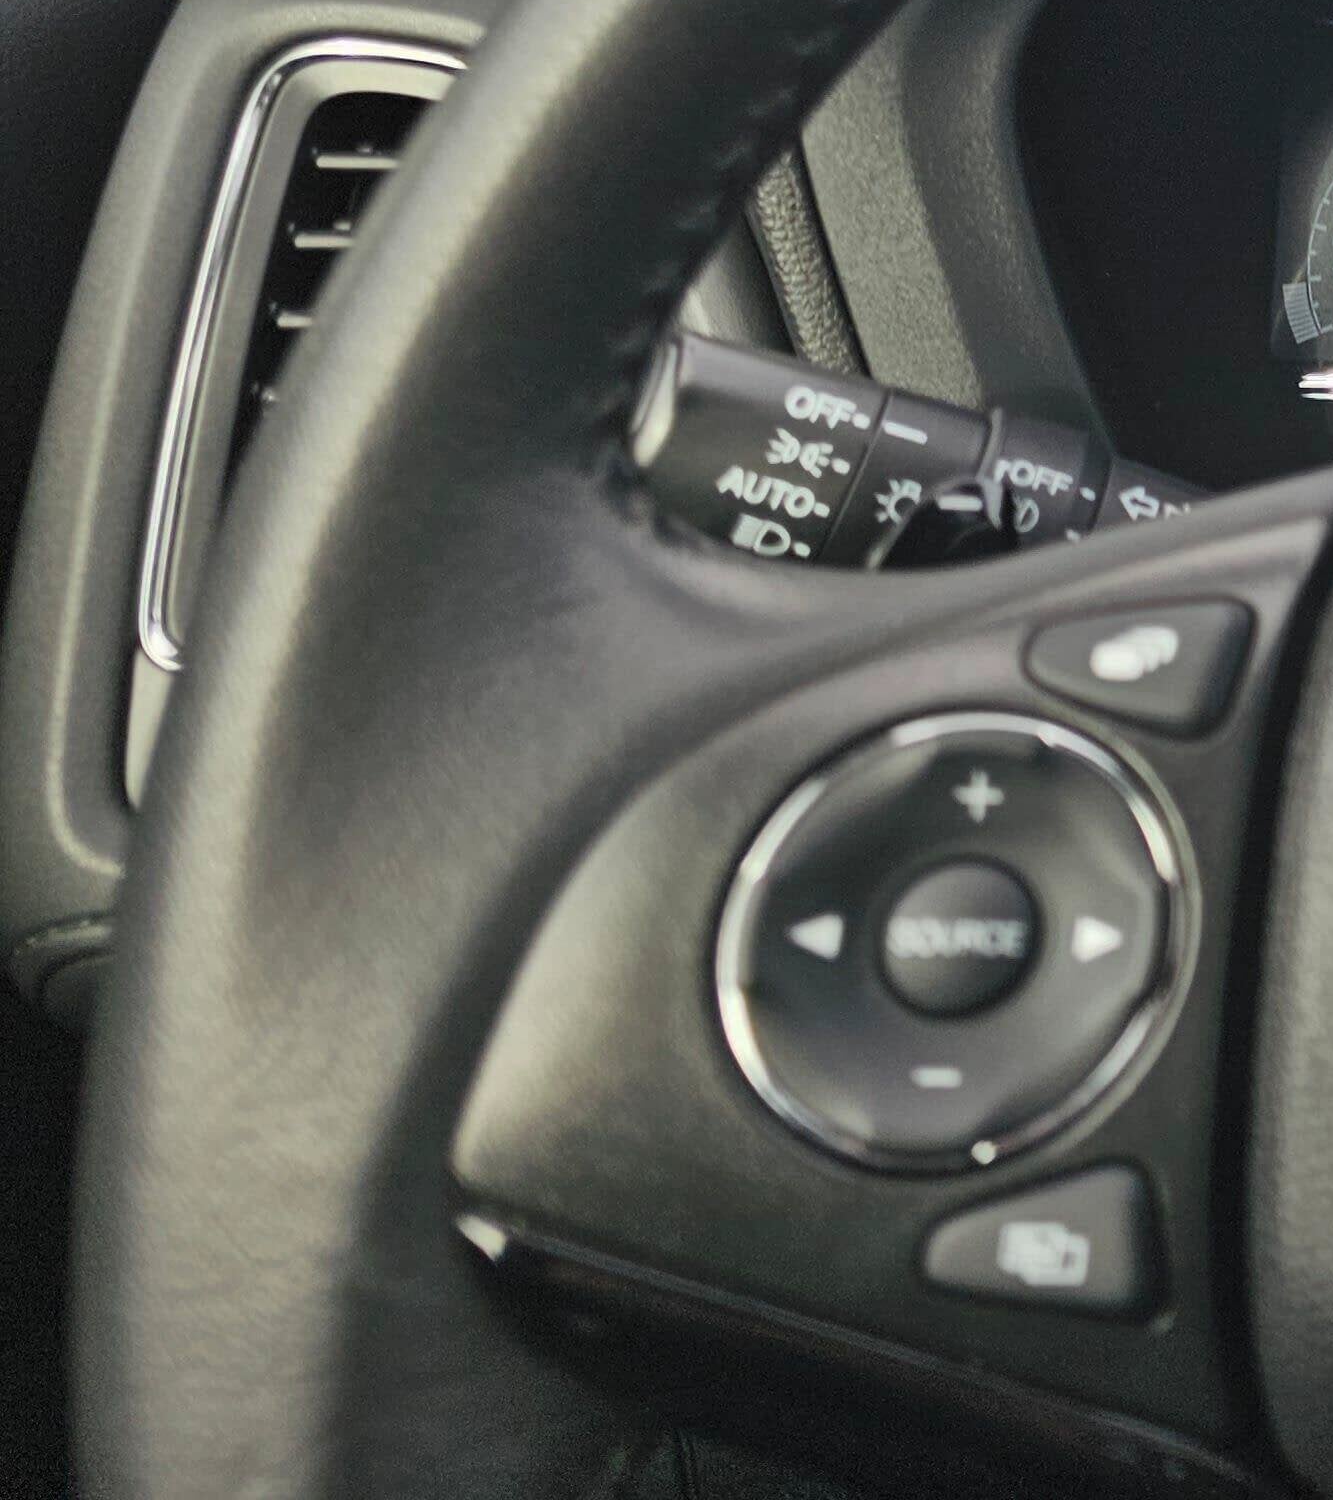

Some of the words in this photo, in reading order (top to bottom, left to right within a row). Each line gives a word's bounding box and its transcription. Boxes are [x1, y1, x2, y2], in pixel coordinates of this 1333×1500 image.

[785, 386, 855, 429] OFF
[716, 465, 815, 519] AUTO
[886, 915, 1028, 960] SOURCE
